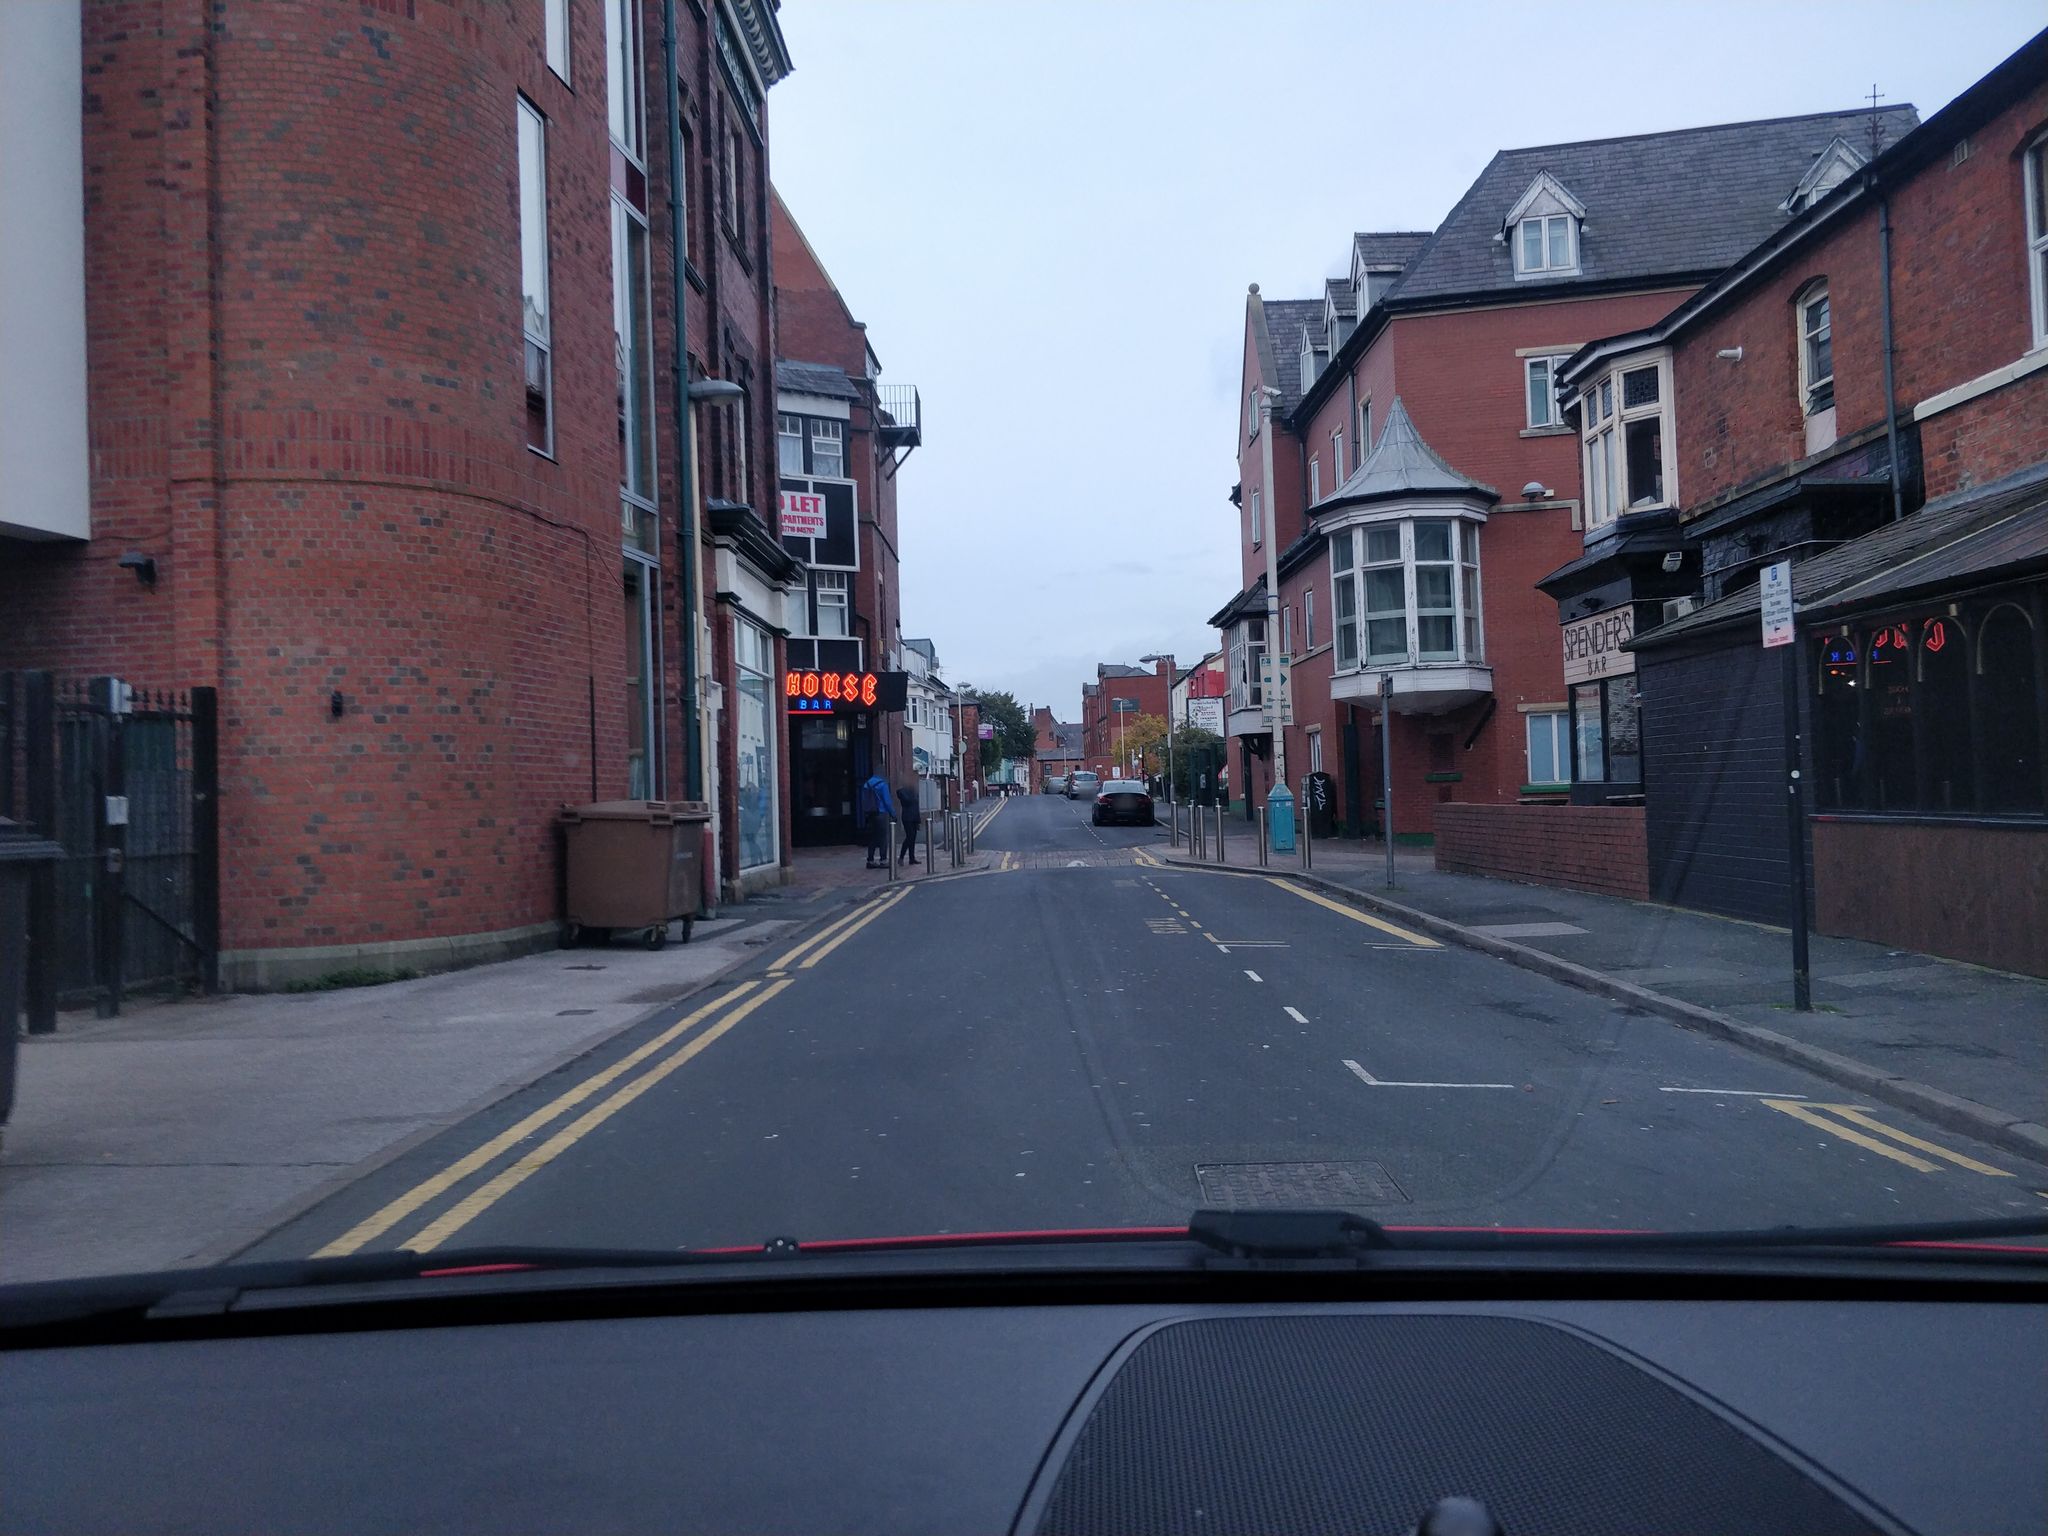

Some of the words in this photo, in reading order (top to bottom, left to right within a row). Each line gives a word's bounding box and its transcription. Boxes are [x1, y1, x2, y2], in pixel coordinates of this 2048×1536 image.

[790, 495, 821, 513] LET
[1565, 610, 1631, 661] SPENDER'S
[1588, 656, 1607, 676] BAR
[786, 672, 877, 706] HOUSE
[800, 699, 832, 710] BAR
